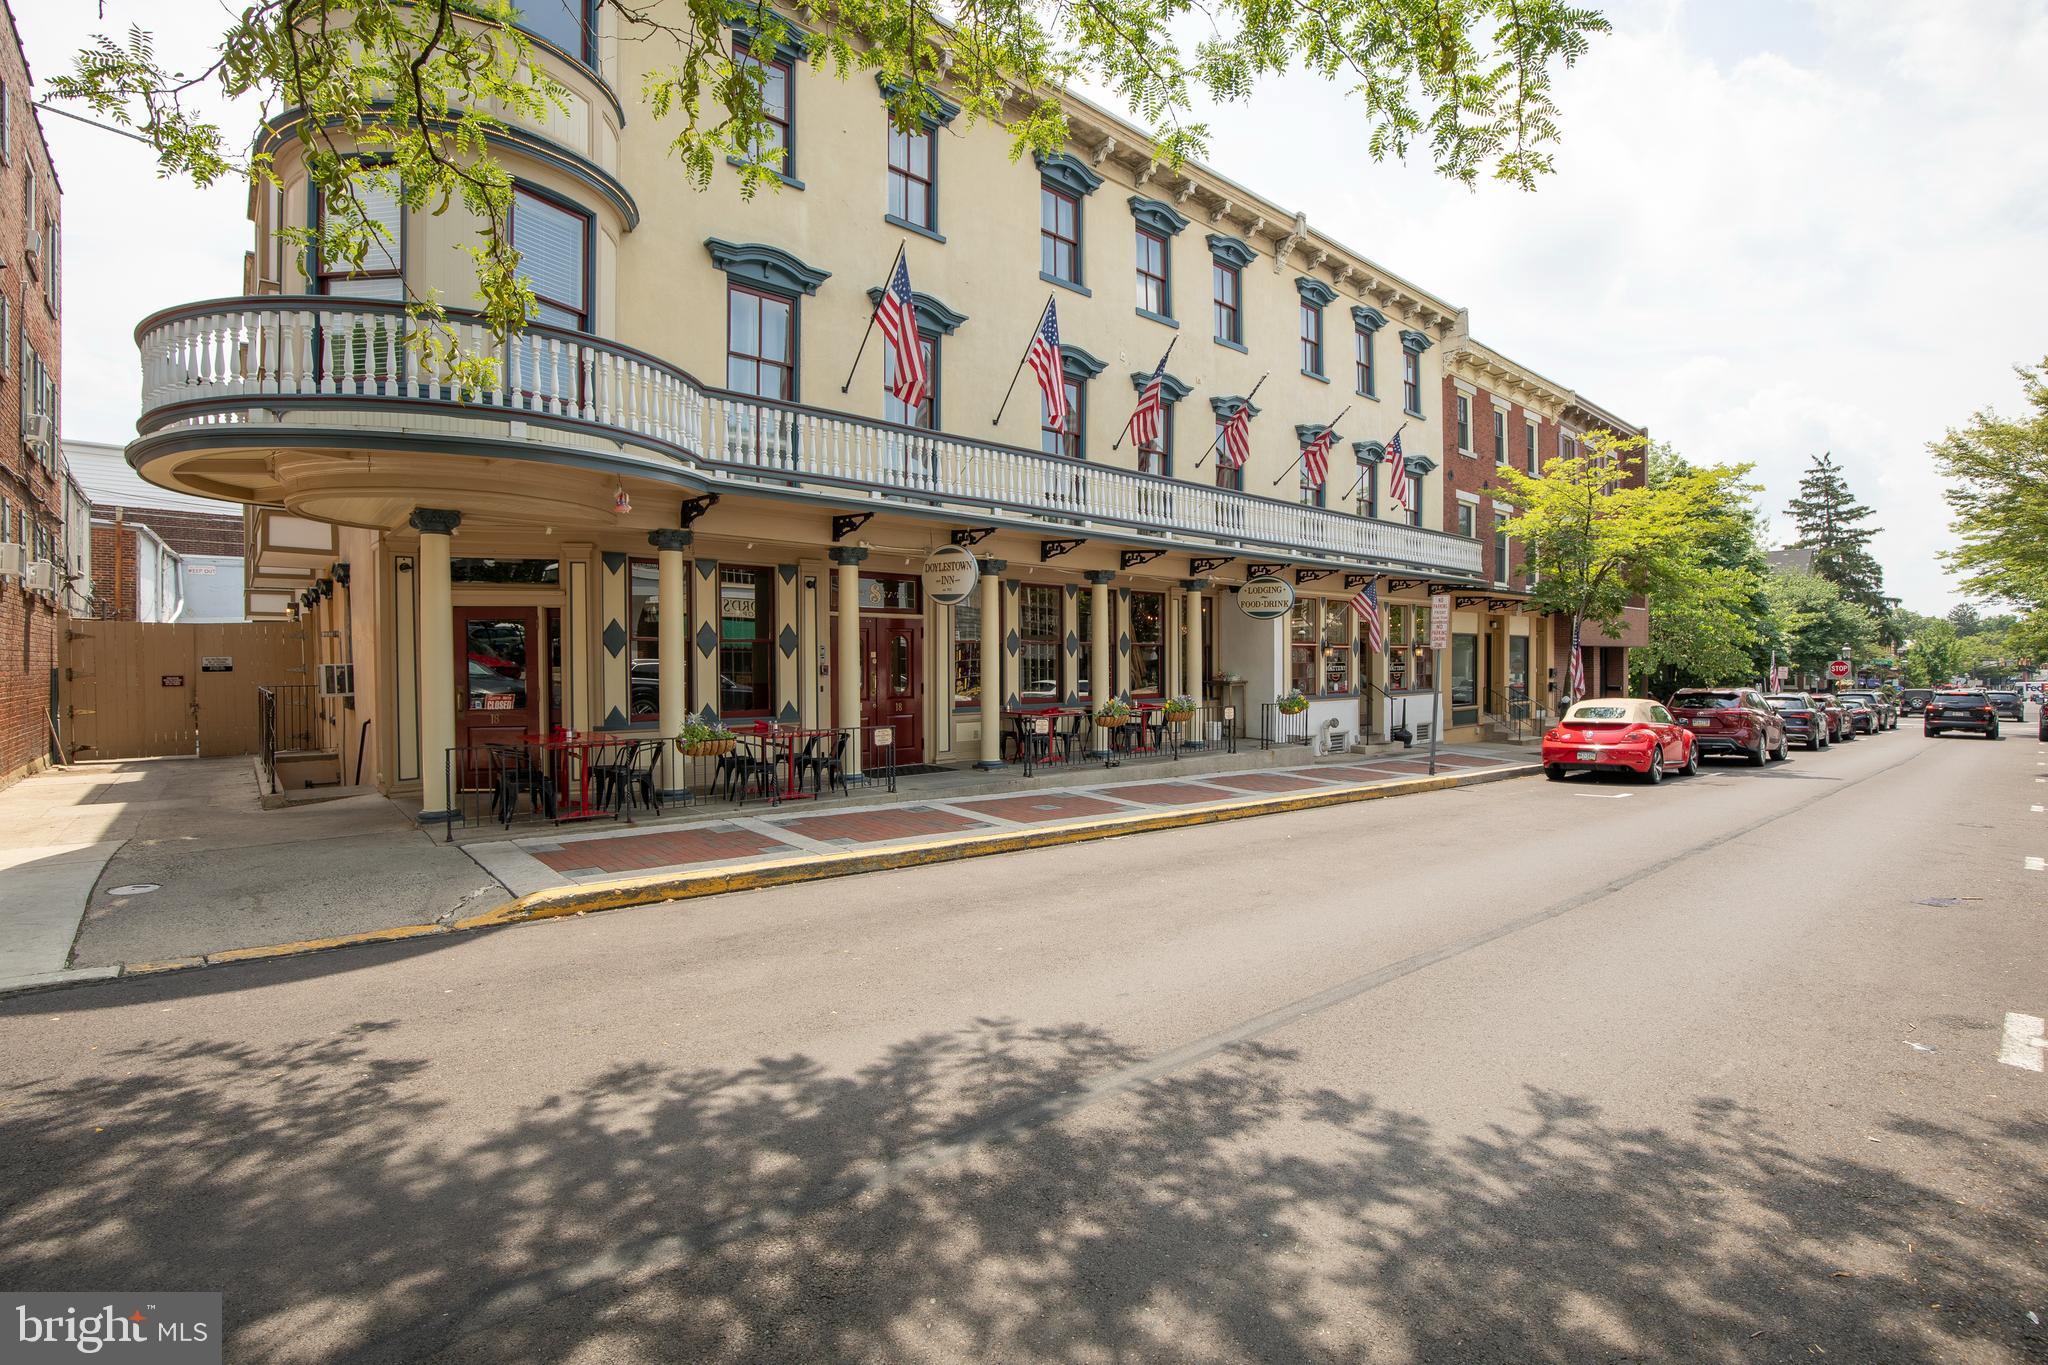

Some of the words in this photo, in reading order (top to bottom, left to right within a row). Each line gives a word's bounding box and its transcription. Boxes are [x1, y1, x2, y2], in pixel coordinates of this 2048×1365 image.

[924, 560, 972, 573] DOYLESTOWN
[941, 575, 955, 585] INN
[1247, 586, 1282, 594] LODGING
[487, 700, 512, 709] CLOSED
